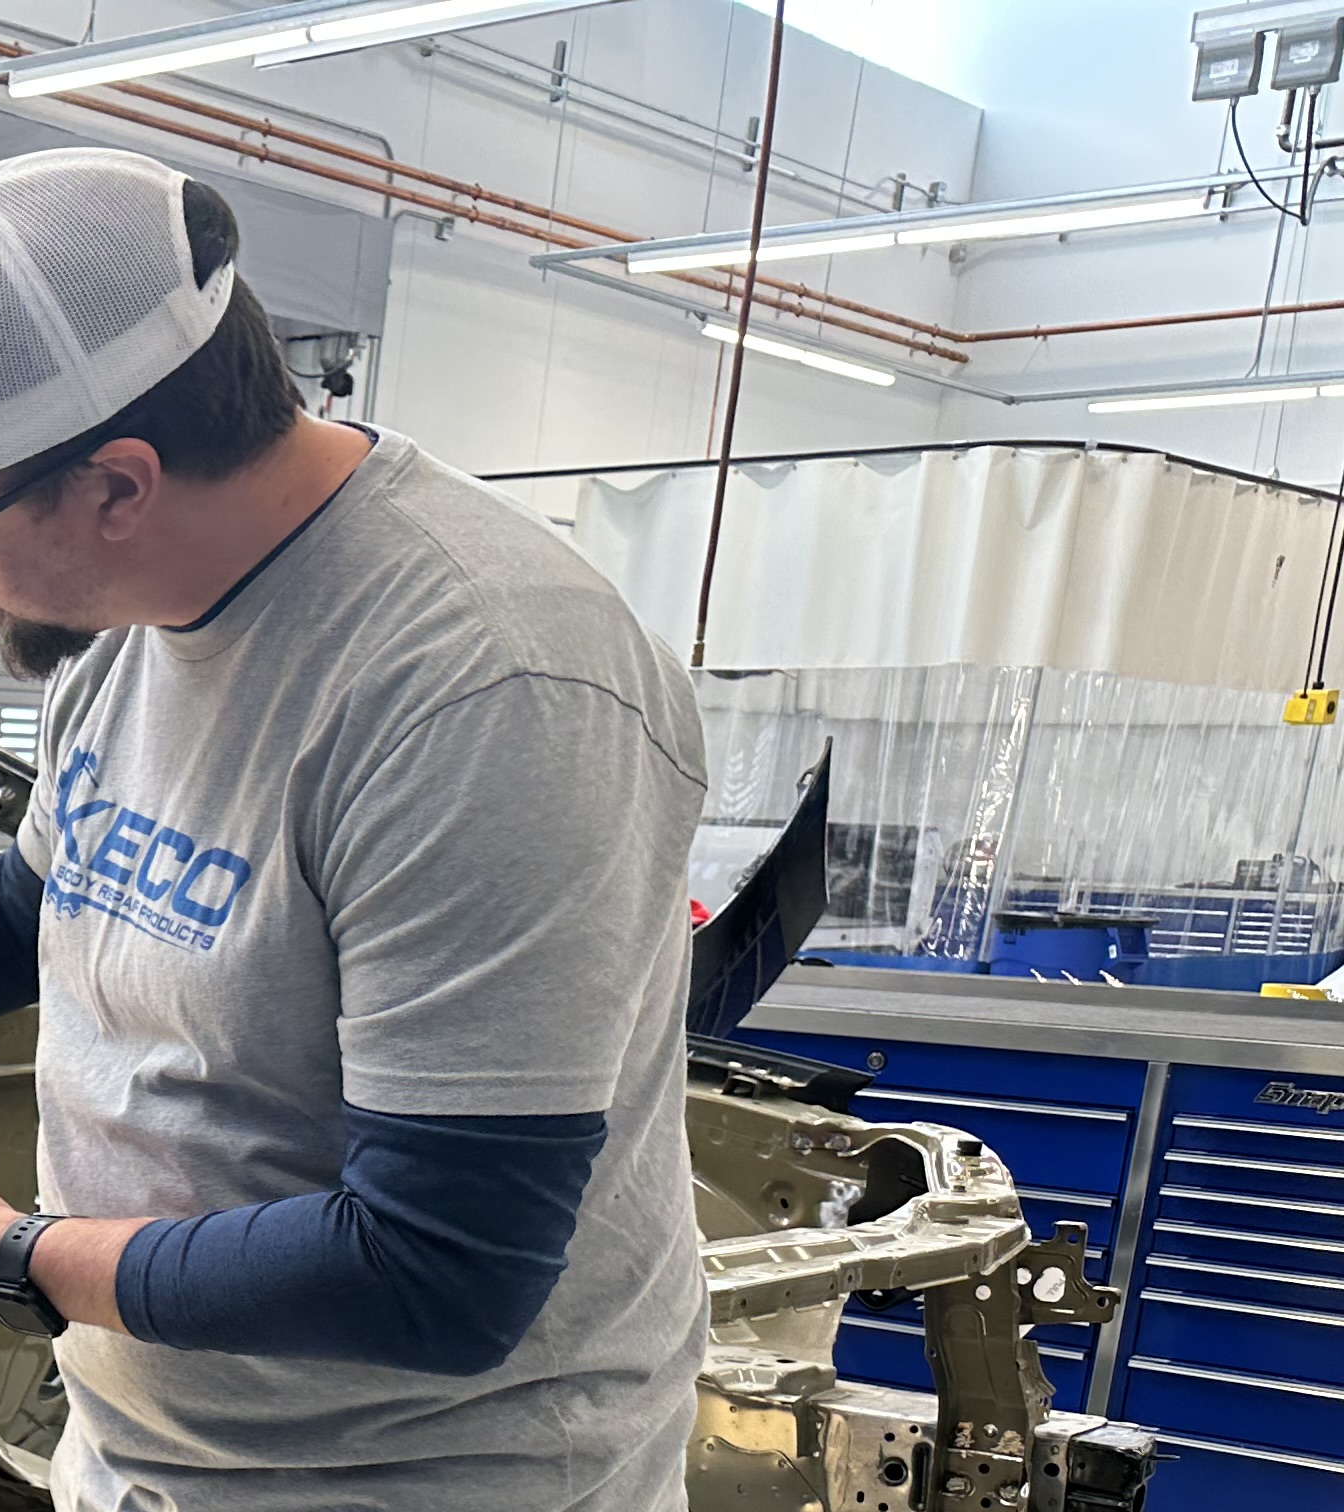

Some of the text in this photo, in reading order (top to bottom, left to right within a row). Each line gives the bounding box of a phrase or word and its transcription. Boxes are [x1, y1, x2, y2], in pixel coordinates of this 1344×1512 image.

[56, 864, 96, 892] BODY
[137, 904, 216, 951] PRODUCTS
[63, 799, 252, 927] KECO
